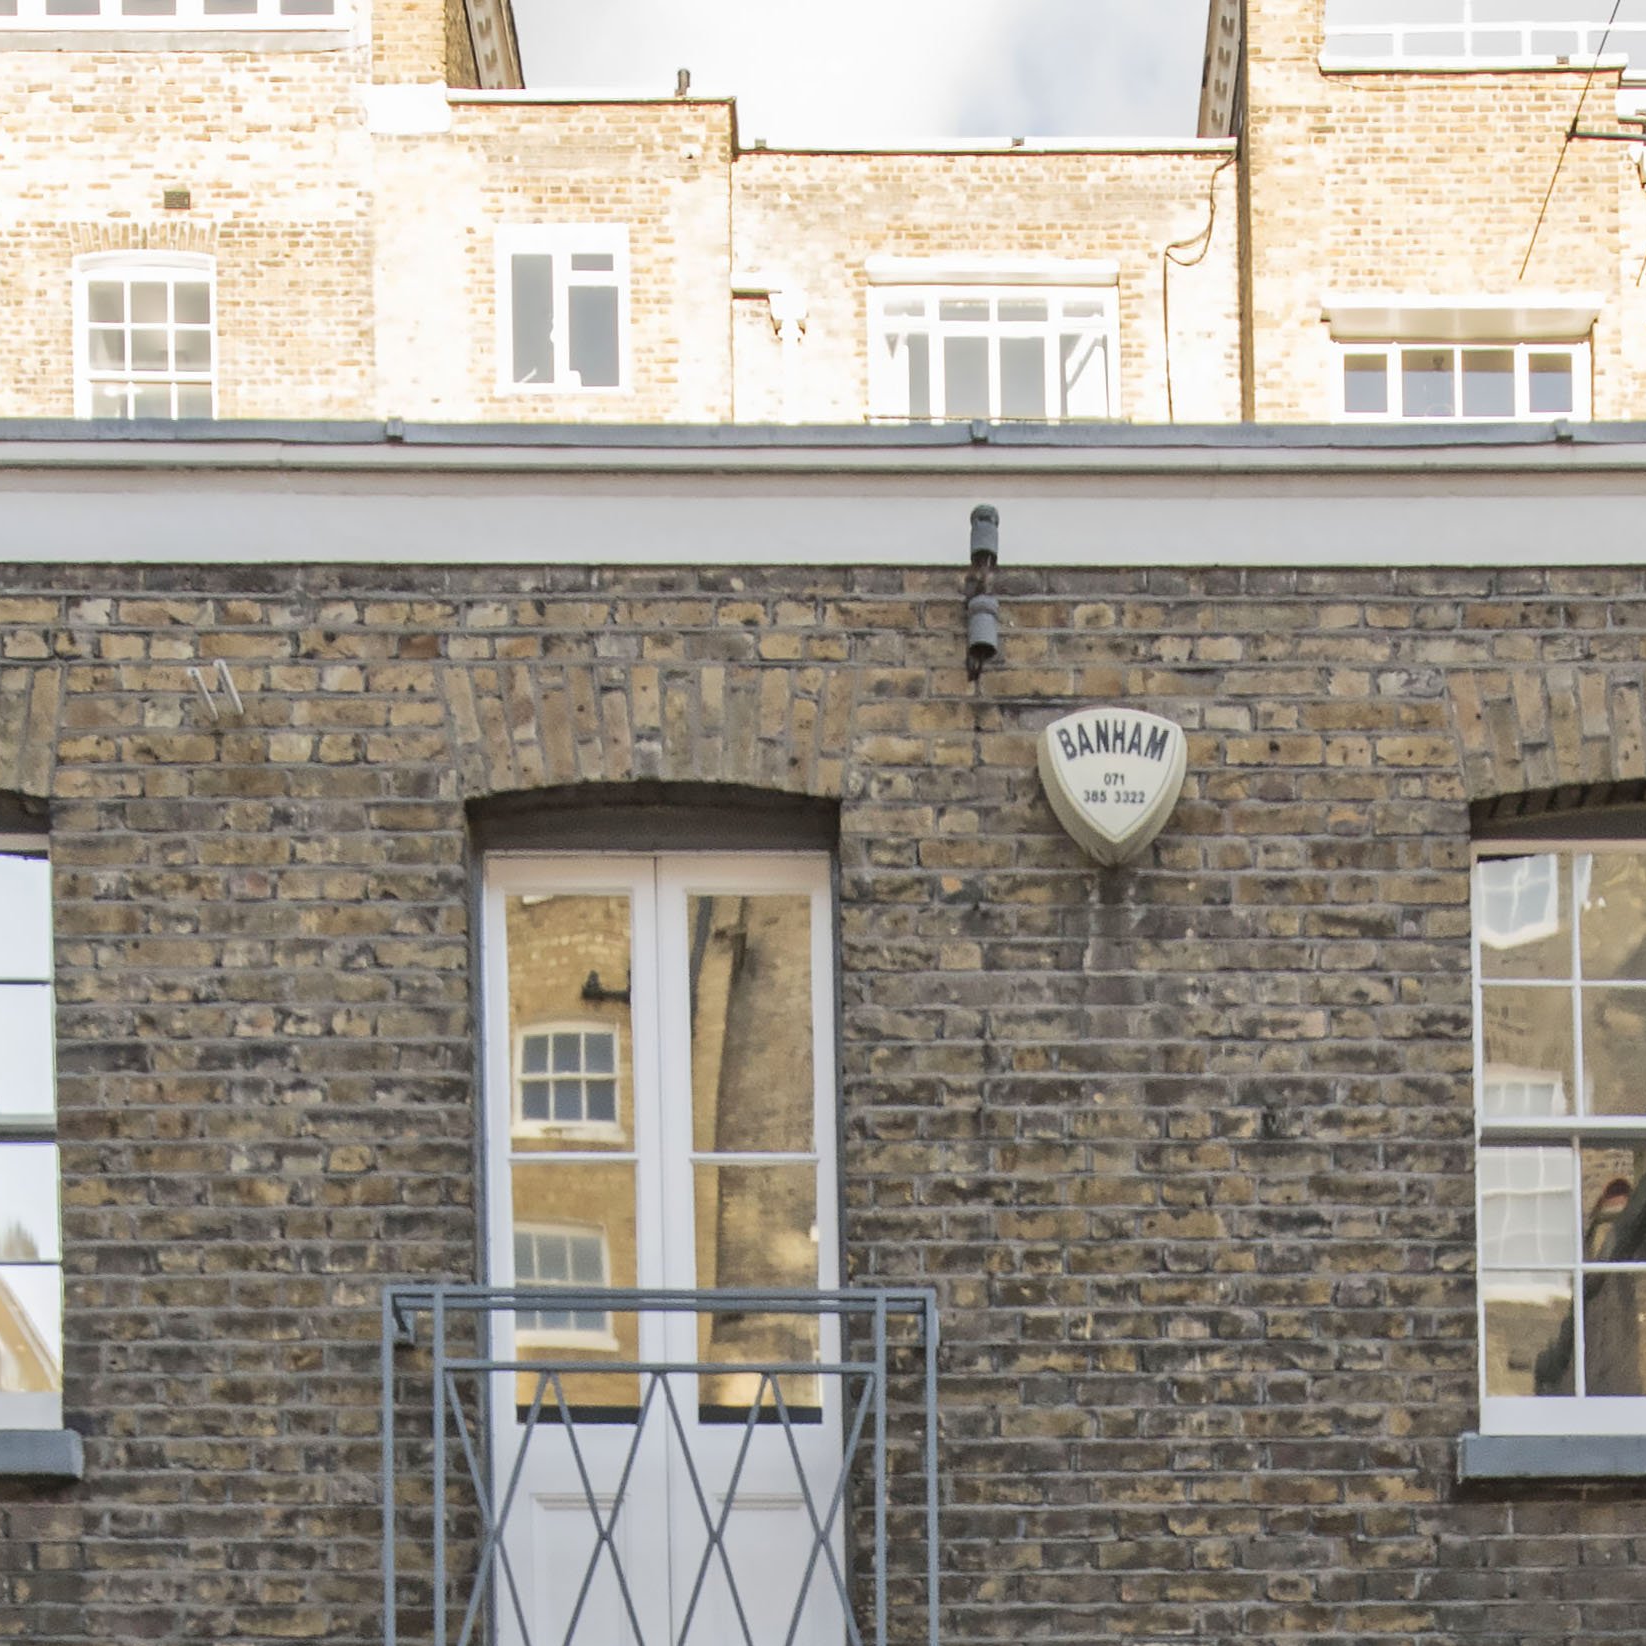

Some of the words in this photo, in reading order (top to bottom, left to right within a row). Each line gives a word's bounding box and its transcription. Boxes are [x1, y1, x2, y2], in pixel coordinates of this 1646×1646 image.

[1056, 719, 1170, 762] BANHAM
[1103, 772, 1125, 786] 071
[1114, 790, 1146, 804] 3322
